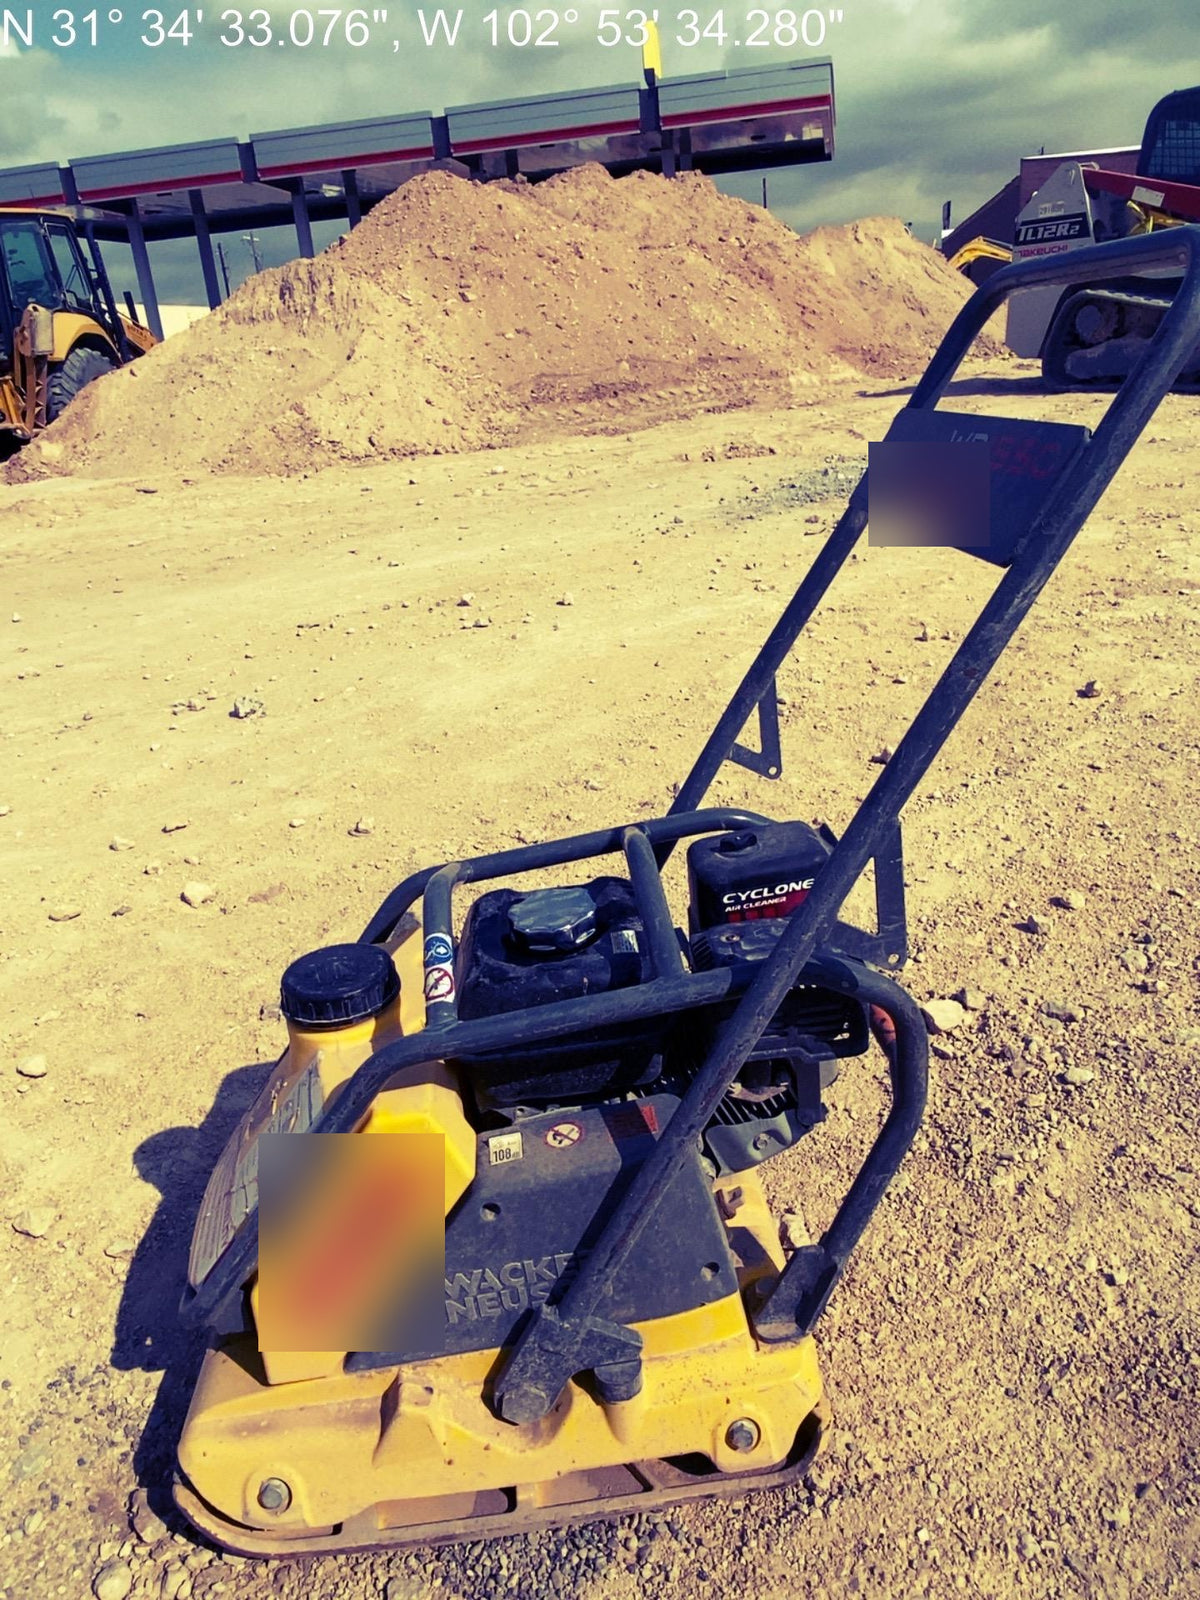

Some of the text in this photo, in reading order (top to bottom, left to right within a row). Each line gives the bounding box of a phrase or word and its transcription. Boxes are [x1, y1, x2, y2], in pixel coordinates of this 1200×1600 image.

[1018, 223, 1080, 242] TL12R2
[722, 878, 815, 904] CYCLONE
[724, 896, 787, 913] AIR CLEANER
[492, 1147, 512, 1162] 108
